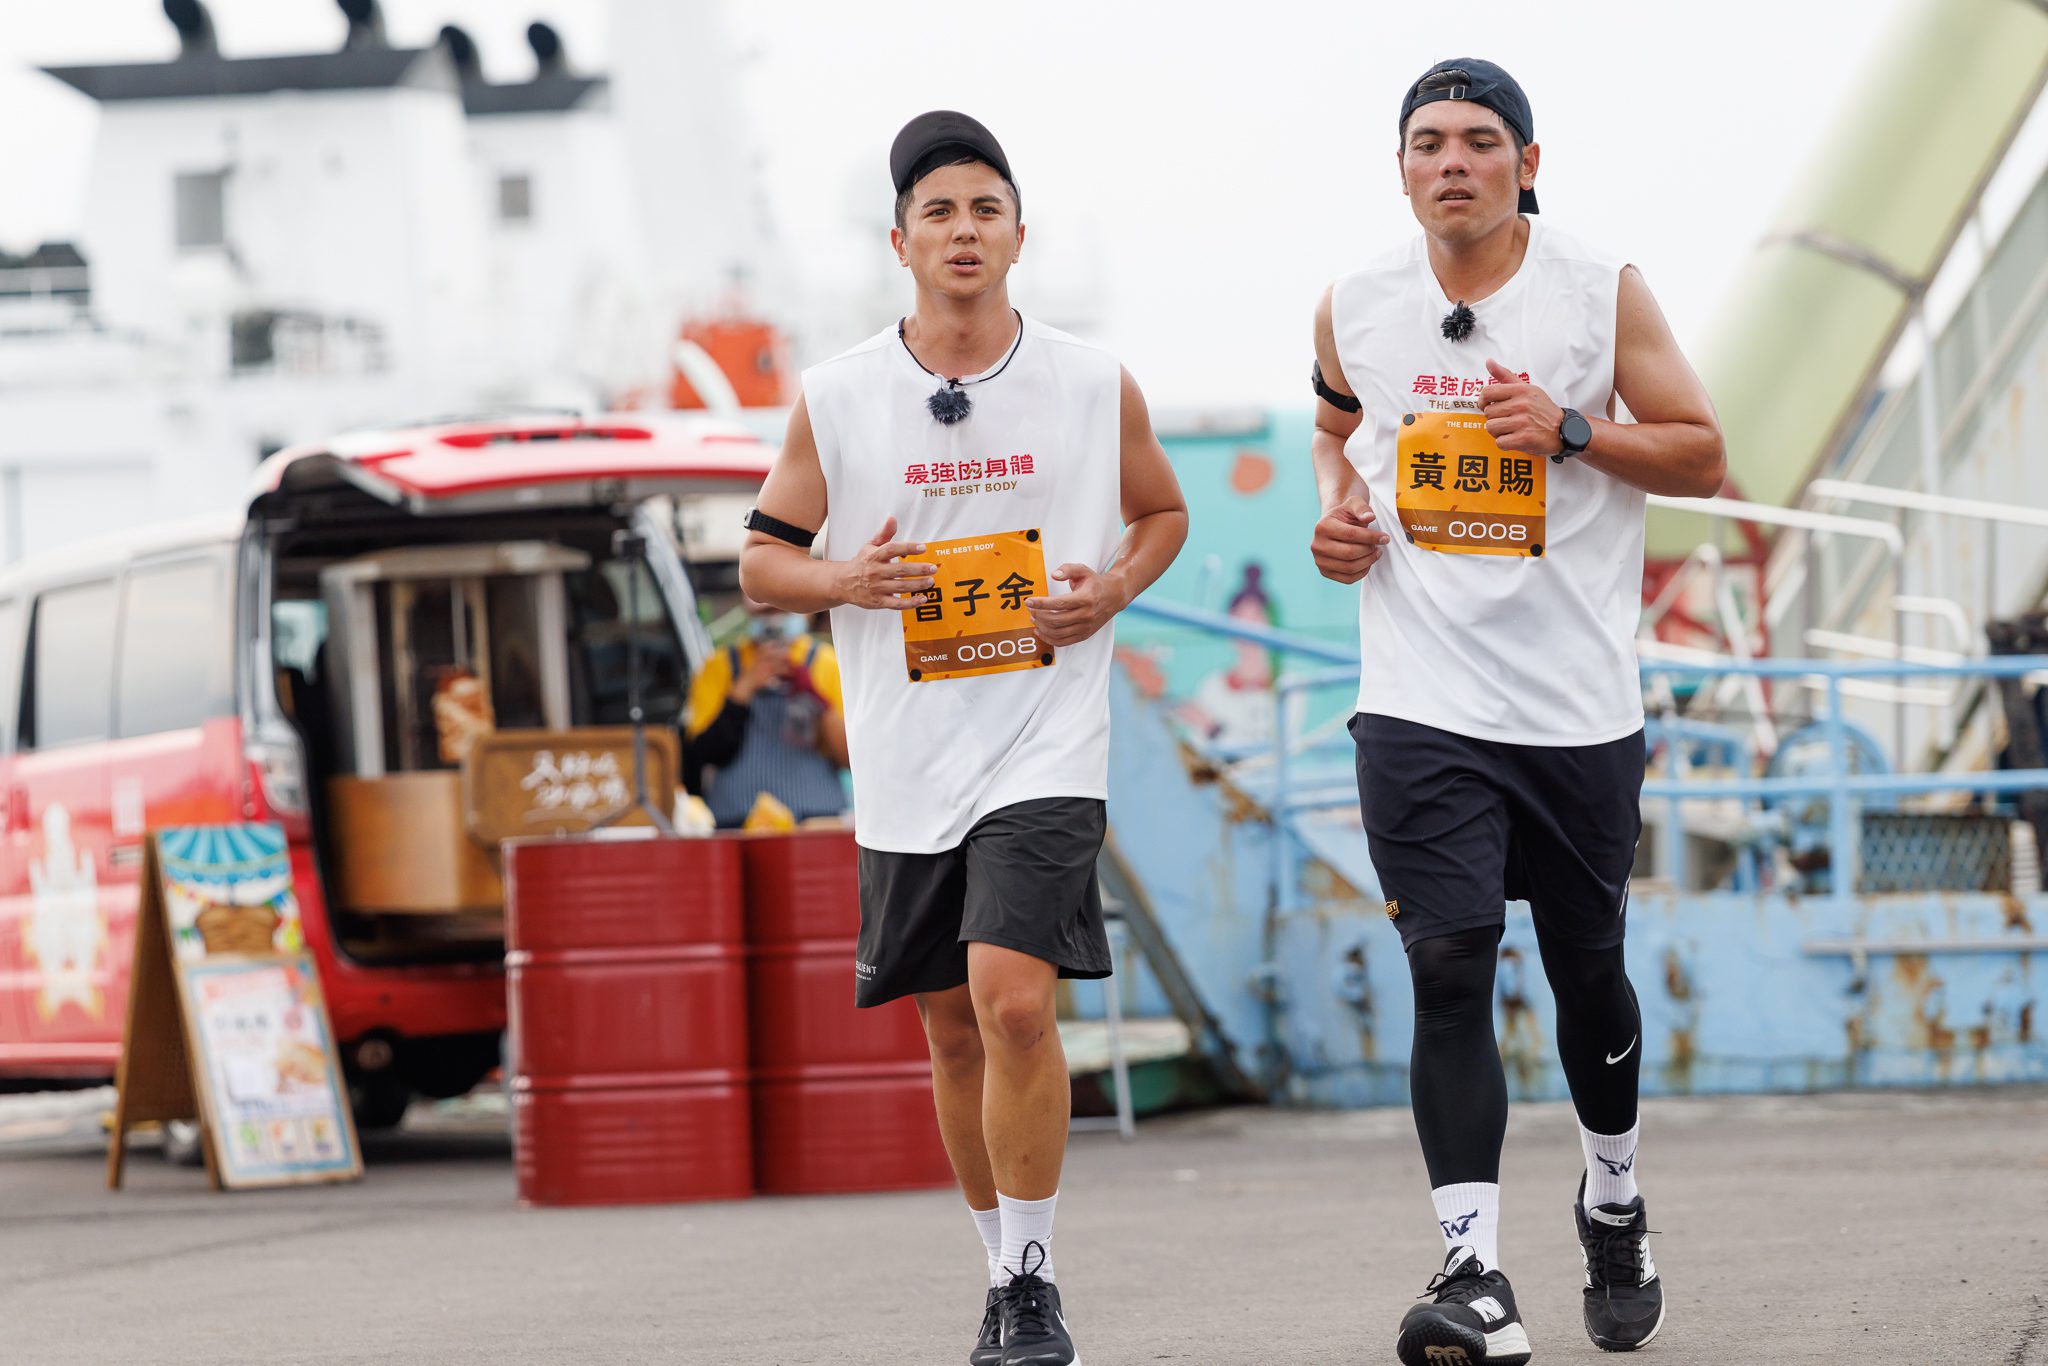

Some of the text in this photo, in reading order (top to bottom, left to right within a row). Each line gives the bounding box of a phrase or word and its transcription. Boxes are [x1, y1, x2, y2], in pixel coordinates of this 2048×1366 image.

[1429, 399, 1450, 410] THE
[1446, 420, 1461, 429] THE
[1462, 421, 1482, 429] BEST
[904, 453, 1035, 485] 最強的身體
[1409, 451, 1535, 496] 黃恩賜
[922, 480, 1018, 498] THE BEST BODY
[1411, 520, 1527, 541] GAME 0008
[935, 542, 995, 557] THE BEST BODY
[911, 571, 1035, 622] 曾子余
[920, 636, 1038, 663] GAME 0008
